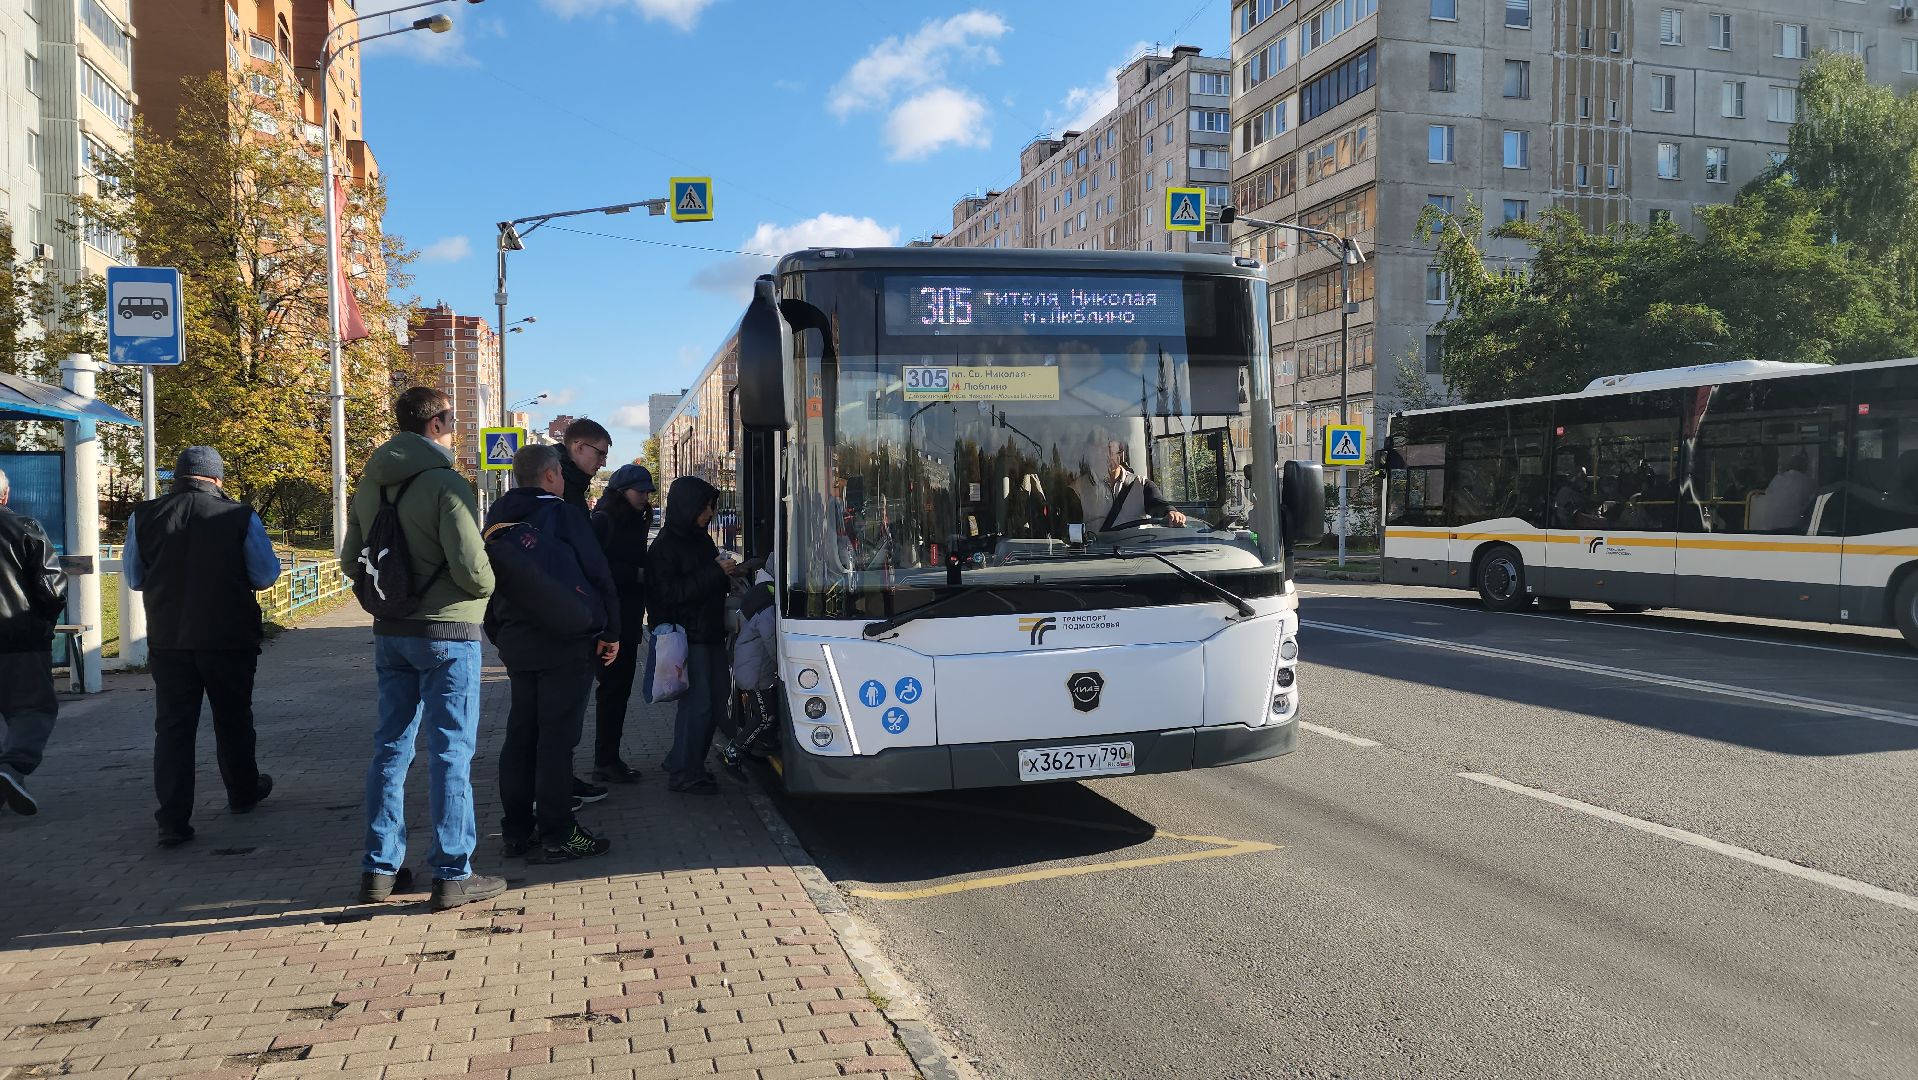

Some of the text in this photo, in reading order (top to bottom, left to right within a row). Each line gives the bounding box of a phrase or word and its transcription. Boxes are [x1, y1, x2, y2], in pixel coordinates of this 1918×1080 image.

[983, 289, 1157, 306] тителя Николая
[921, 287, 972, 324] 305
[908, 369, 948, 388] 305
[985, 370, 1026, 378] Николая
[963, 383, 1008, 391] Люблино
[1063, 614, 1106, 623] ТРАНСПОРТ
[1063, 621, 1120, 631] ПОДМОСКОВЬЯ
[1100, 746, 1127, 761] 790
